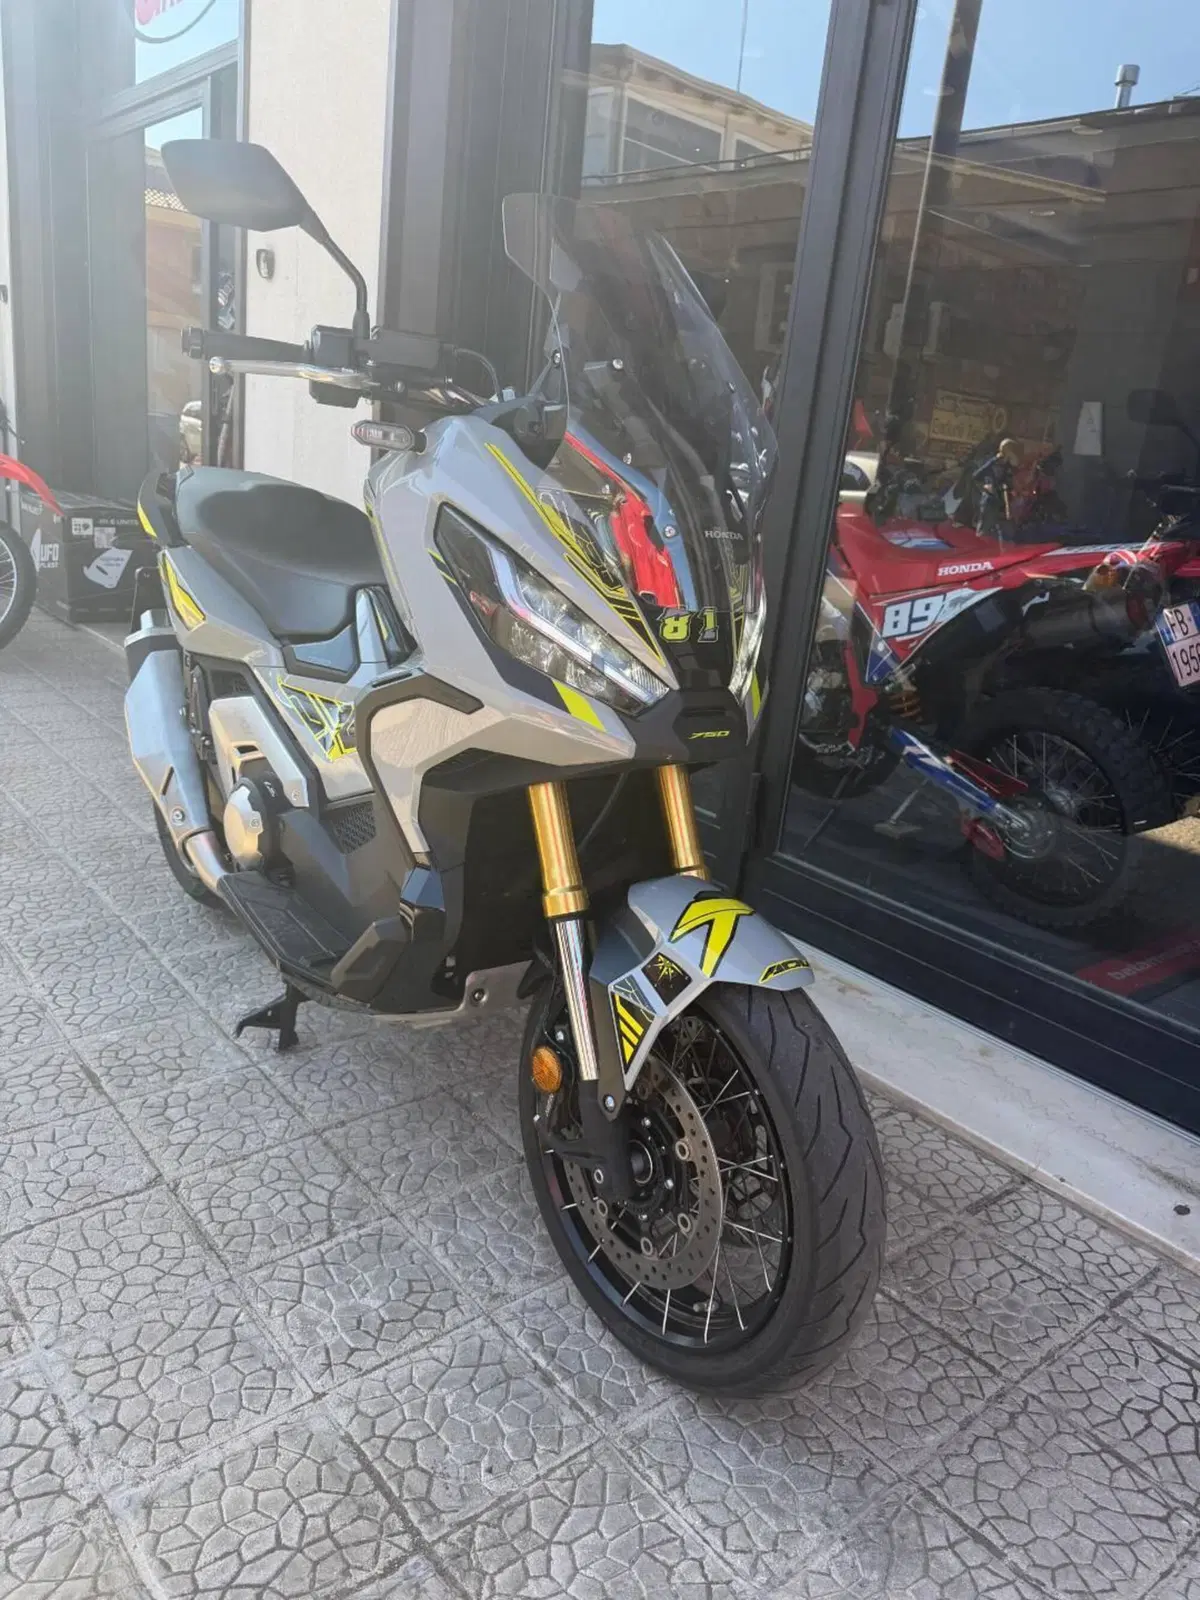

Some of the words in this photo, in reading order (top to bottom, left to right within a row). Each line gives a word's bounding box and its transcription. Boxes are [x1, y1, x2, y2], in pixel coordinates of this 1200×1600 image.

[704, 530, 744, 541] HONDA
[40, 543, 60, 562] UFO
[937, 561, 993, 577] HONDA
[656, 607, 719, 643] 81
[688, 730, 730, 740] 750
